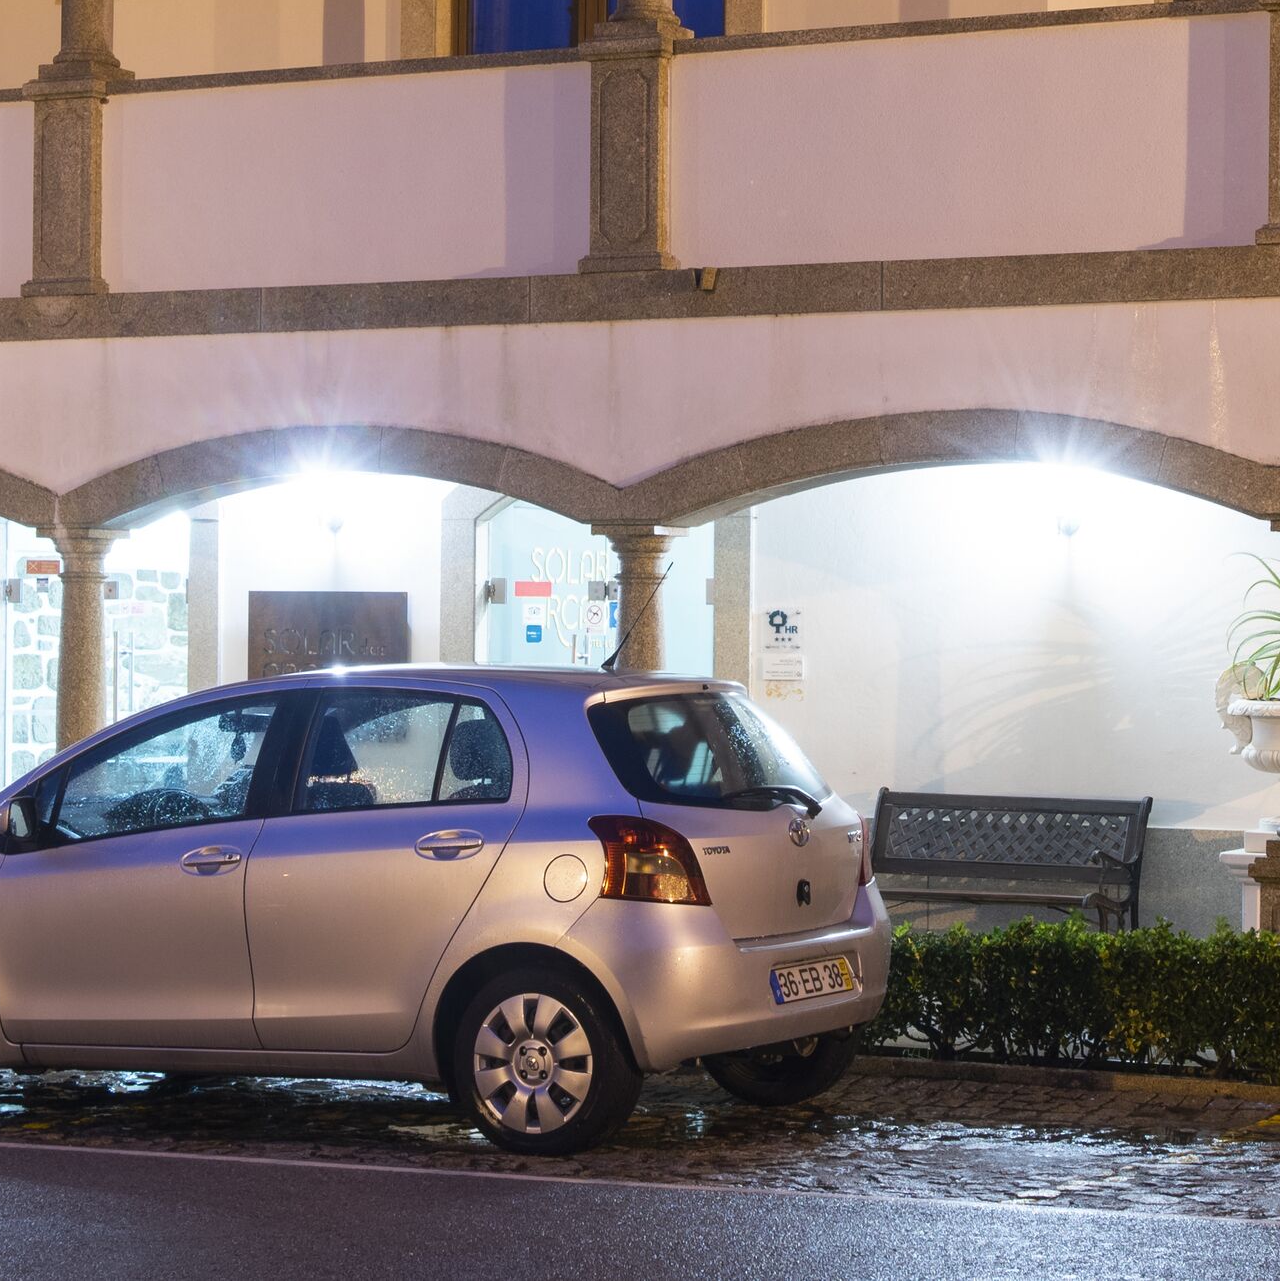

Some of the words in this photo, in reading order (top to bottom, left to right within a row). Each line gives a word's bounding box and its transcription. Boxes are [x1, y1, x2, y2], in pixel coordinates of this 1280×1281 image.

[531, 547, 609, 585] SOLAR
[785, 626, 798, 634] HR
[263, 628, 356, 655] SOLAR
[702, 845, 731, 856] TOYOTA
